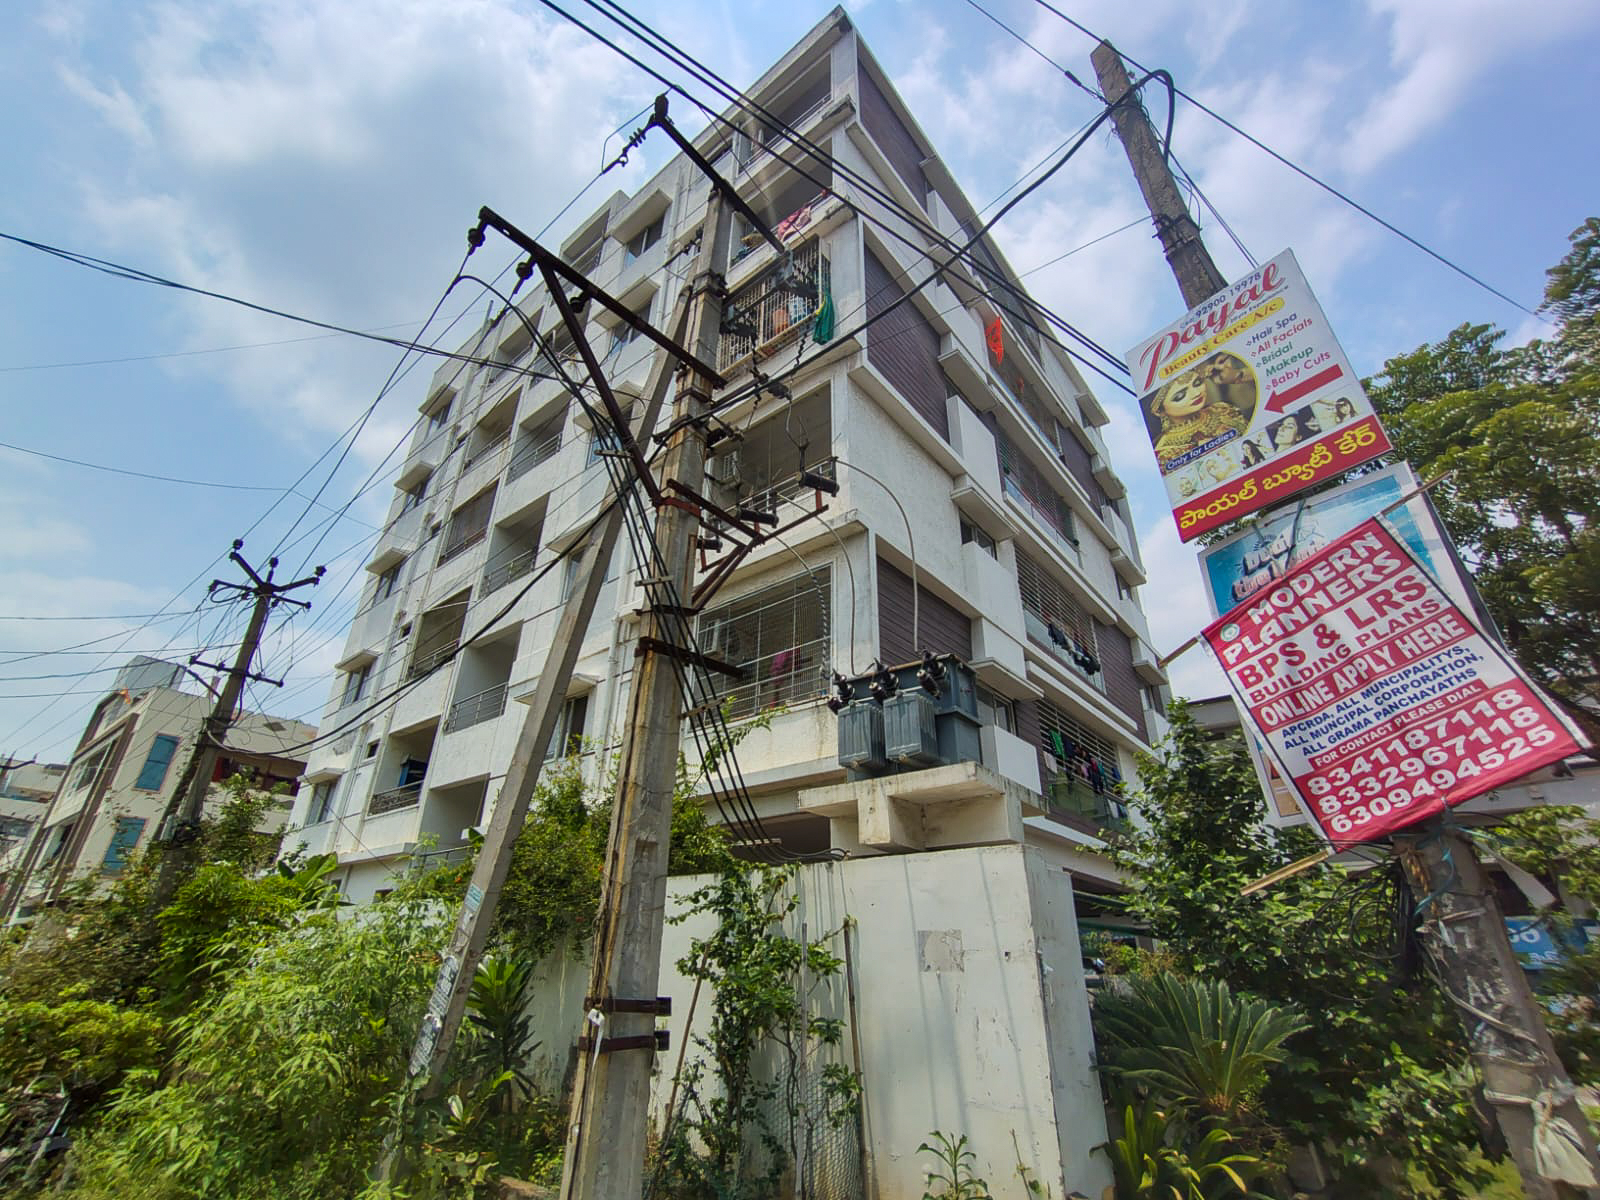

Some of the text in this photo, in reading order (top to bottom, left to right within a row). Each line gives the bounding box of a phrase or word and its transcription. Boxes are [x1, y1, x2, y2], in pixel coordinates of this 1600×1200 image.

[1139, 262, 1286, 392] Payal
[1195, 294, 1227, 318] 92900
[1229, 271, 1262, 297] 19978
[1251, 312, 1298, 343] Hair Spa
[1257, 318, 1313, 354] All Facials
[1164, 345, 1210, 376] Beauty
[1213, 320, 1249, 345] Care
[1261, 341, 1293, 365] Bridal
[1265, 346, 1313, 377] Makeup
[1271, 351, 1331, 388] Baby Cuts
[1167, 430, 1236, 471] Only for Ladies
[1180, 477, 1258, 530] పాయల్
[1222, 550, 1402, 666] PLANNERS
[1247, 531, 1384, 625] MODERN
[1235, 574, 1428, 690] BPS & LRS
[1249, 598, 1441, 704] BUILDING PLANS
[1259, 613, 1466, 727] ONLINE APPLY HERE
[1281, 644, 1471, 739] APCRDA, ALL MUNCIPALITYS,
[1284, 653, 1485, 750] ALL MUNCIPAL CORPORATION,
[1302, 667, 1478, 757] ALL GRAMA PANCHAYATHS
[1315, 683, 1482, 767] FOR CONTACT PLEASE DIAL
[1306, 688, 1524, 796] 8341187118
[1317, 705, 1541, 815] 8332967118
[1330, 723, 1557, 834] 6309494525
